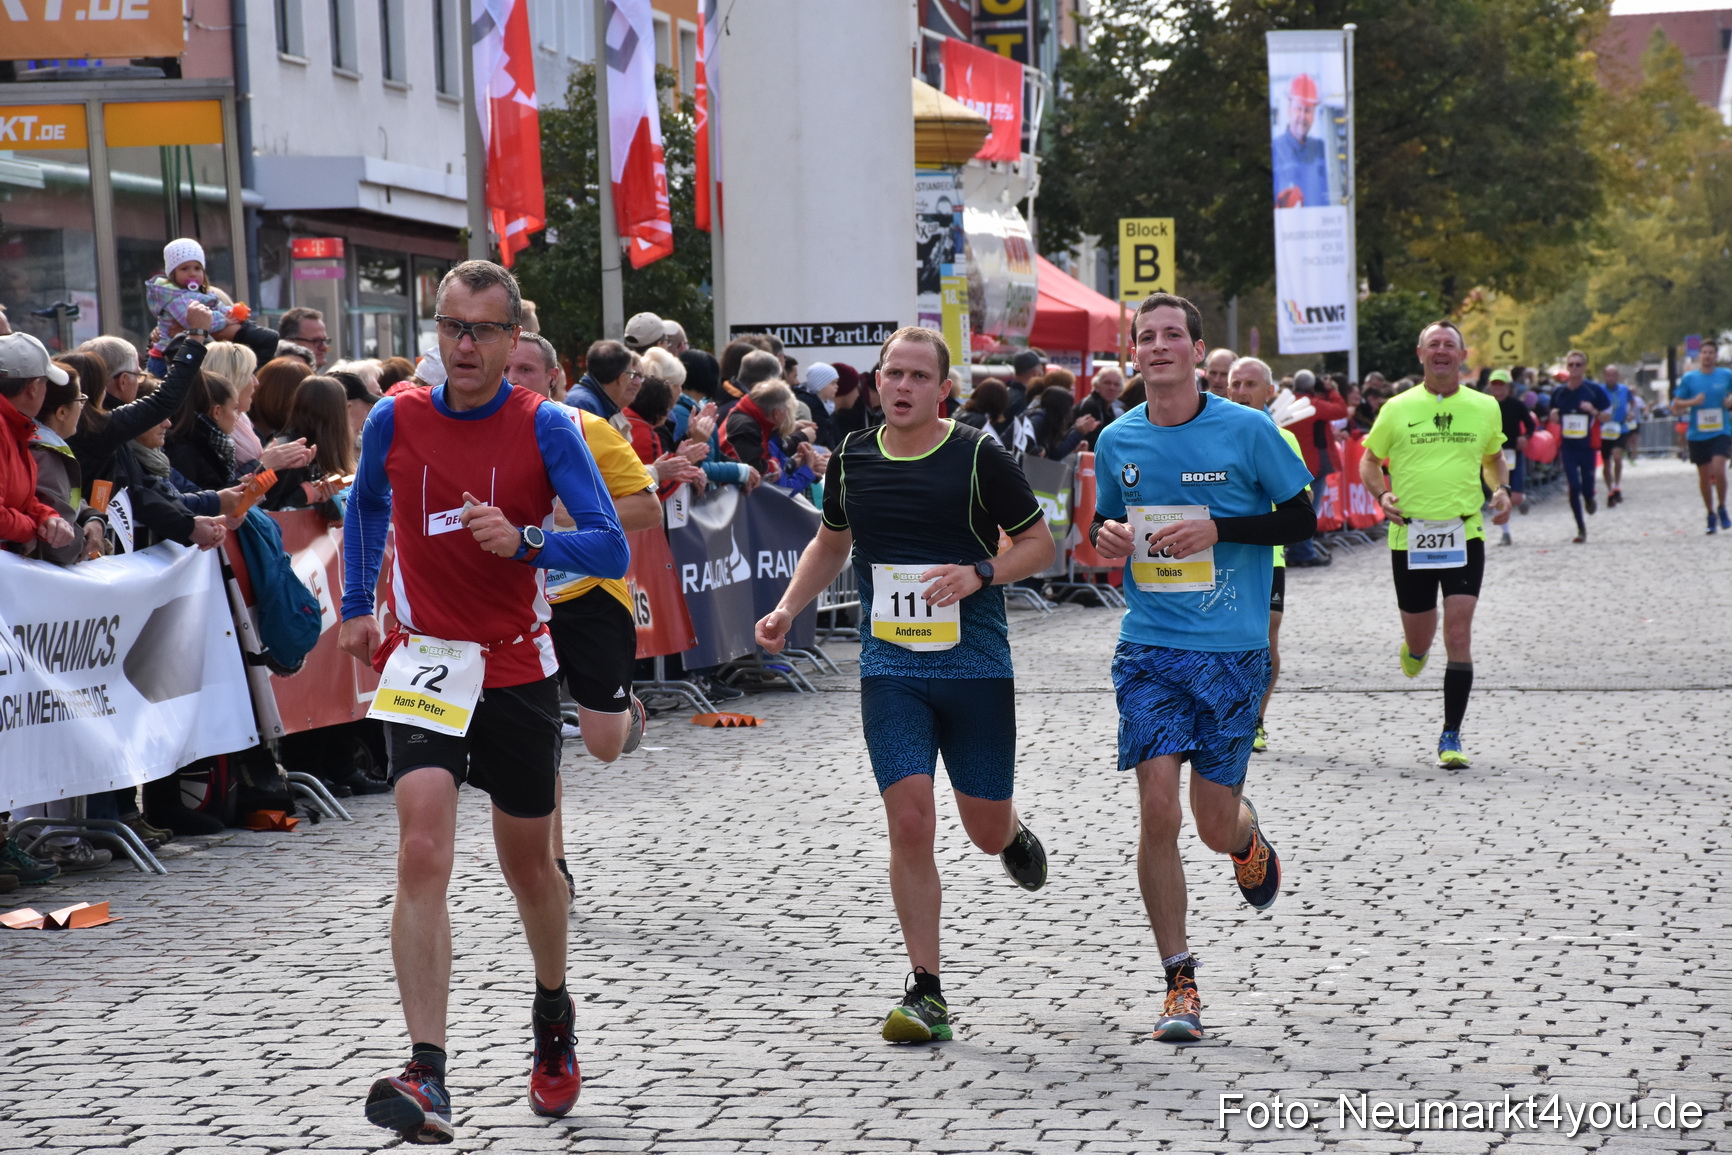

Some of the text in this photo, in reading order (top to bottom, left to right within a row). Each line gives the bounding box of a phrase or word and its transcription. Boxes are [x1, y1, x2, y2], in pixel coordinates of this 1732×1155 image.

[1126, 221, 1168, 237] Block
[1134, 243, 1161, 283] B
[943, 288, 960, 305] 18.
[1499, 330, 1515, 351] C
[1181, 471, 1227, 483] BOCK
[109, 499, 131, 532] swn
[1416, 533, 1455, 549] 2371
[544, 571, 568, 584] chael
[1156, 567, 1183, 577] Tobias
[890, 591, 932, 618] 111
[895, 627, 932, 636] Andreas
[429, 646, 462, 659] BOCK
[410, 664, 449, 694] 72
[394, 695, 446, 717] Hans Peter
